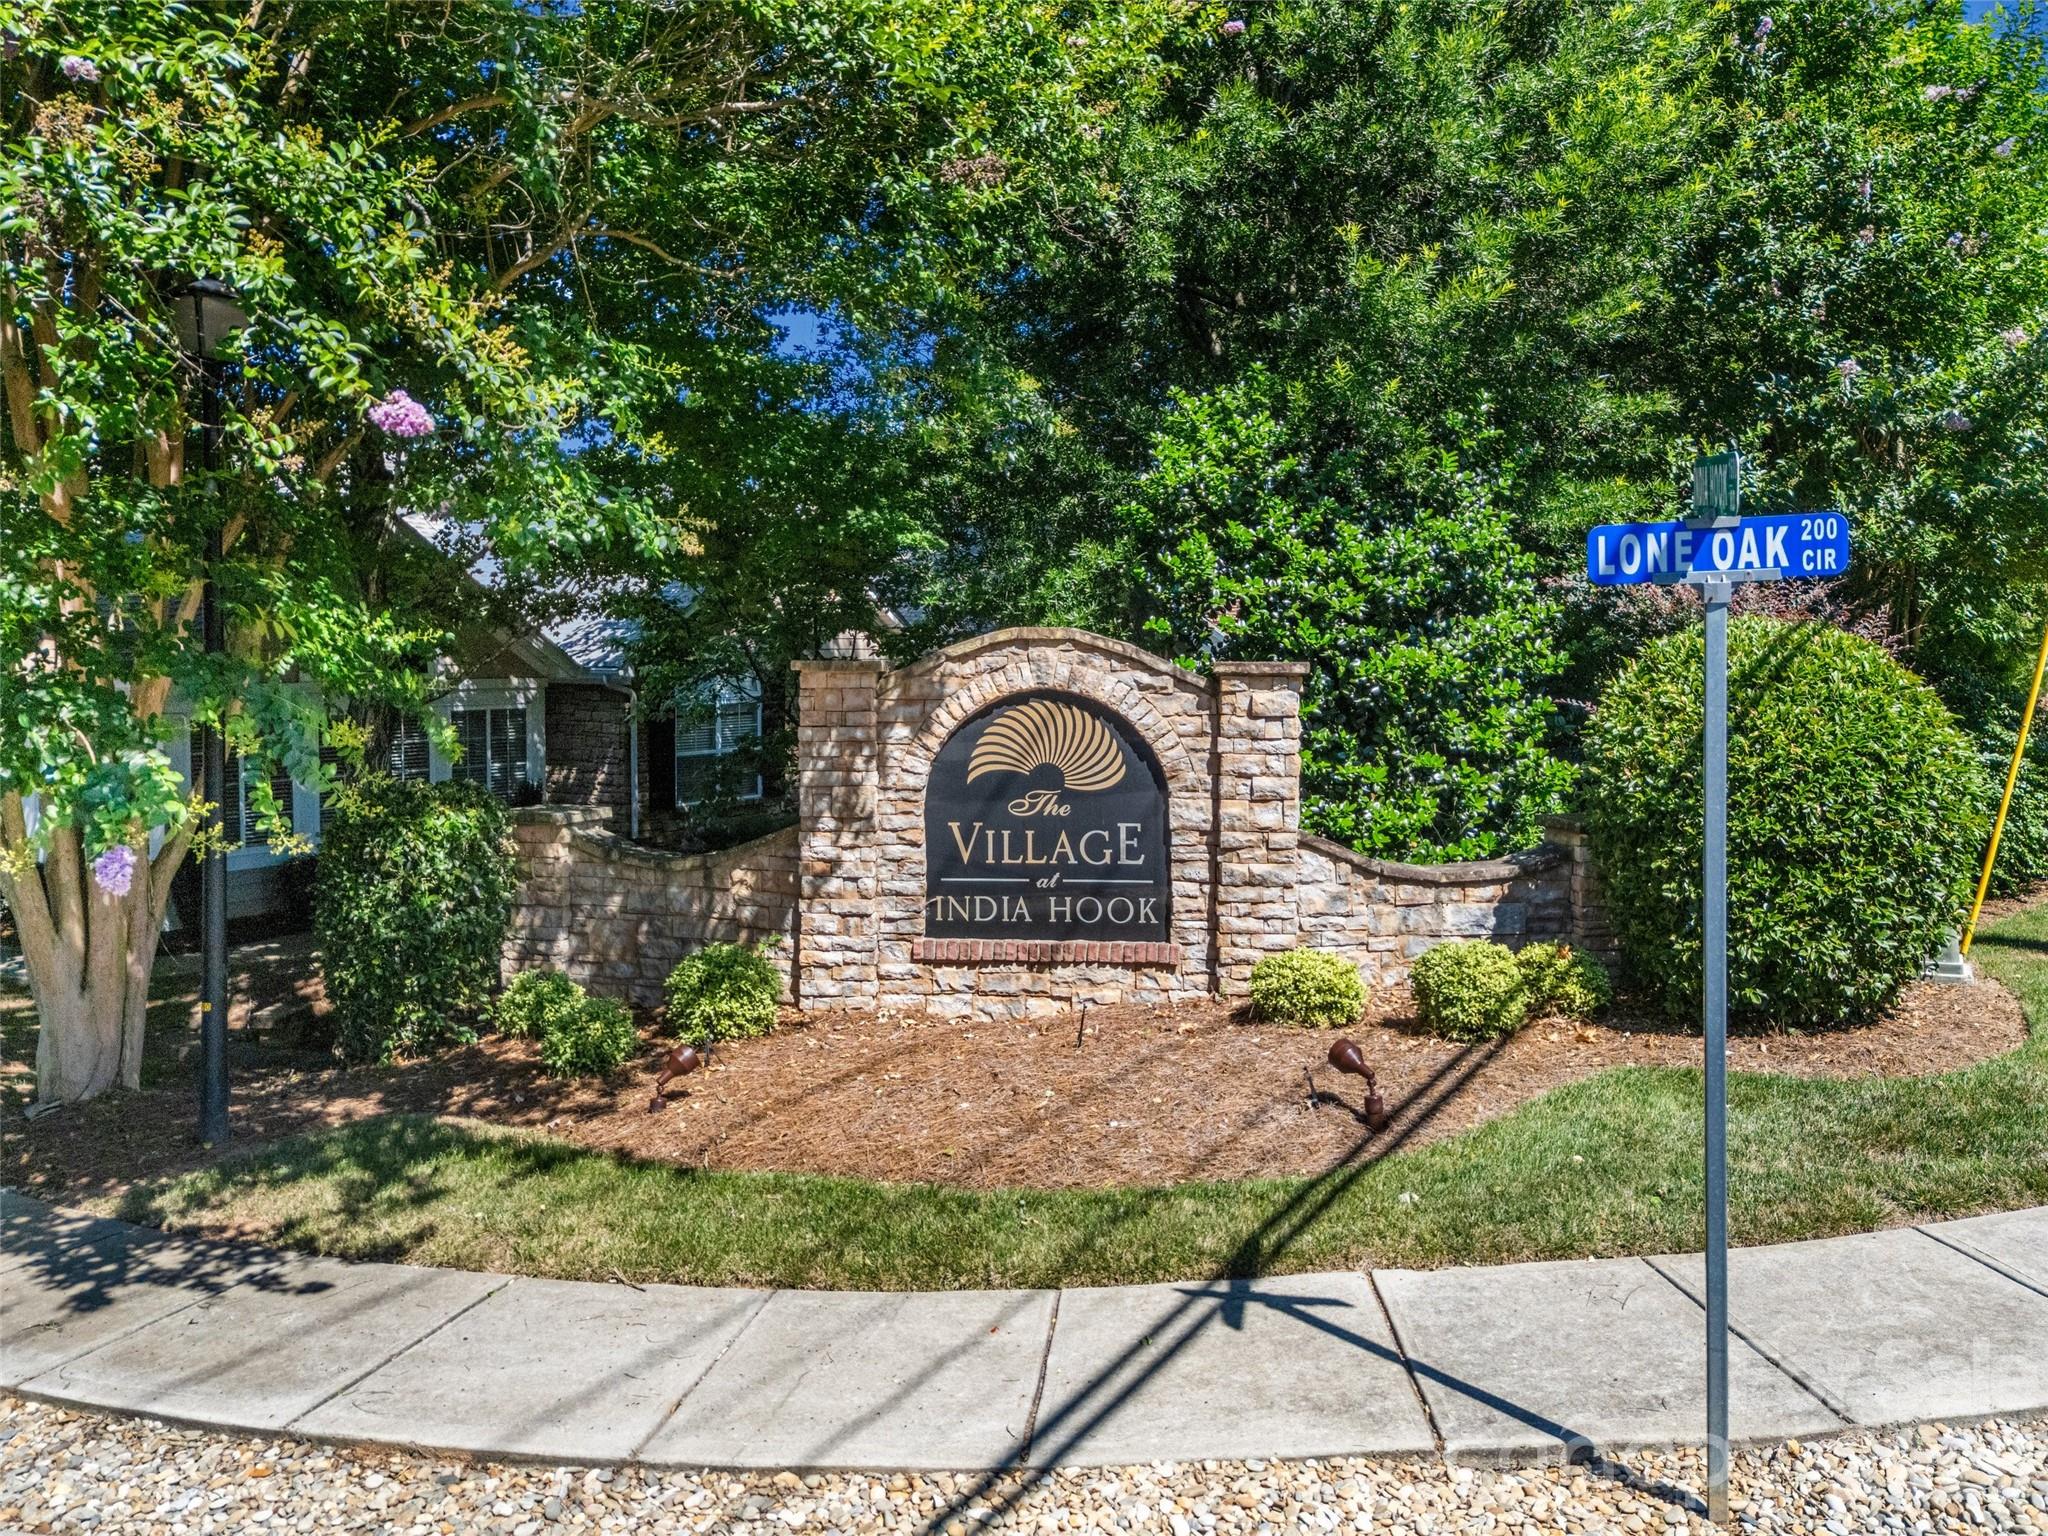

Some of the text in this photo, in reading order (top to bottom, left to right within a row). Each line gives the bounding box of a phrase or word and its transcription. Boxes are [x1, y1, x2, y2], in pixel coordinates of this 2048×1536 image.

[1801, 518, 1838, 541] 200
[1598, 525, 1790, 575] LONE OAK
[1802, 548, 1837, 571] CIR
[1008, 789, 1072, 817] The
[948, 821, 1145, 865] VILLAGE
[1036, 872, 1062, 888] at
[935, 895, 1159, 924] INDIA HOOK
